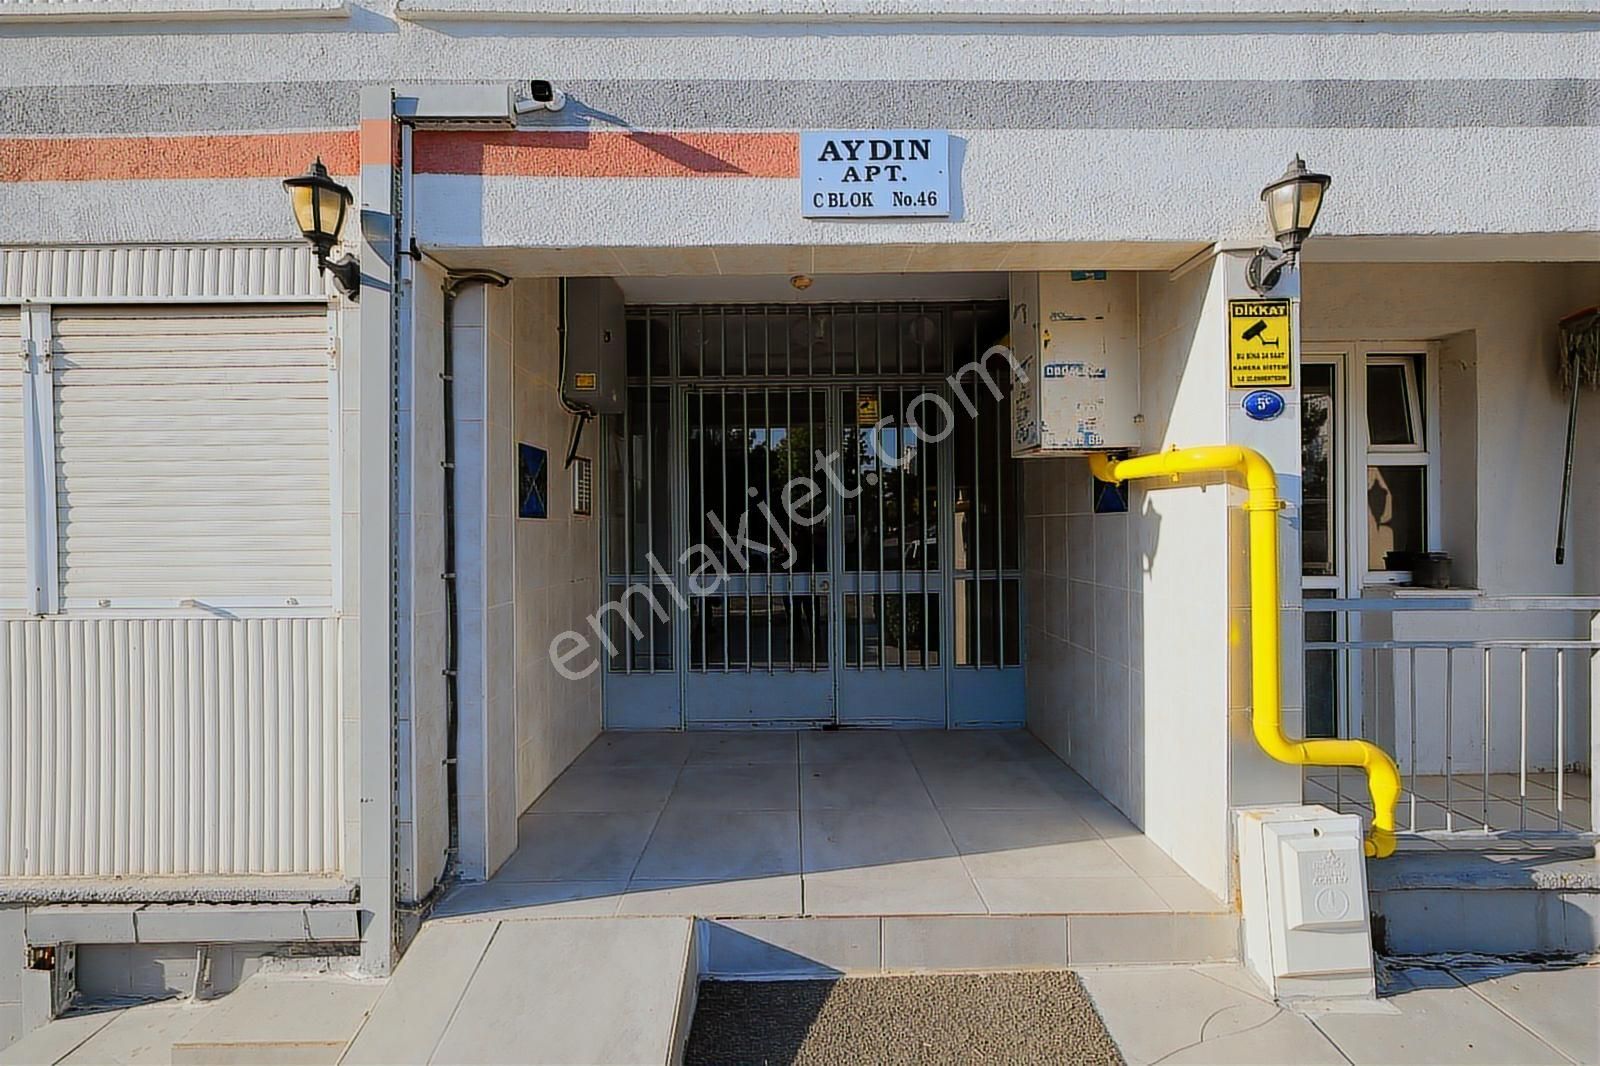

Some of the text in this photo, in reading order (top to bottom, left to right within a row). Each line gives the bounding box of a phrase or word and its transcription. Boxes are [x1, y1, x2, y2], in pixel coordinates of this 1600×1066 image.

[818, 139, 931, 162] AYDIN
[841, 165, 907, 183] APT.
[813, 191, 937, 208] C BLOK No.46
[1234, 303, 1286, 316] DİKKAT
